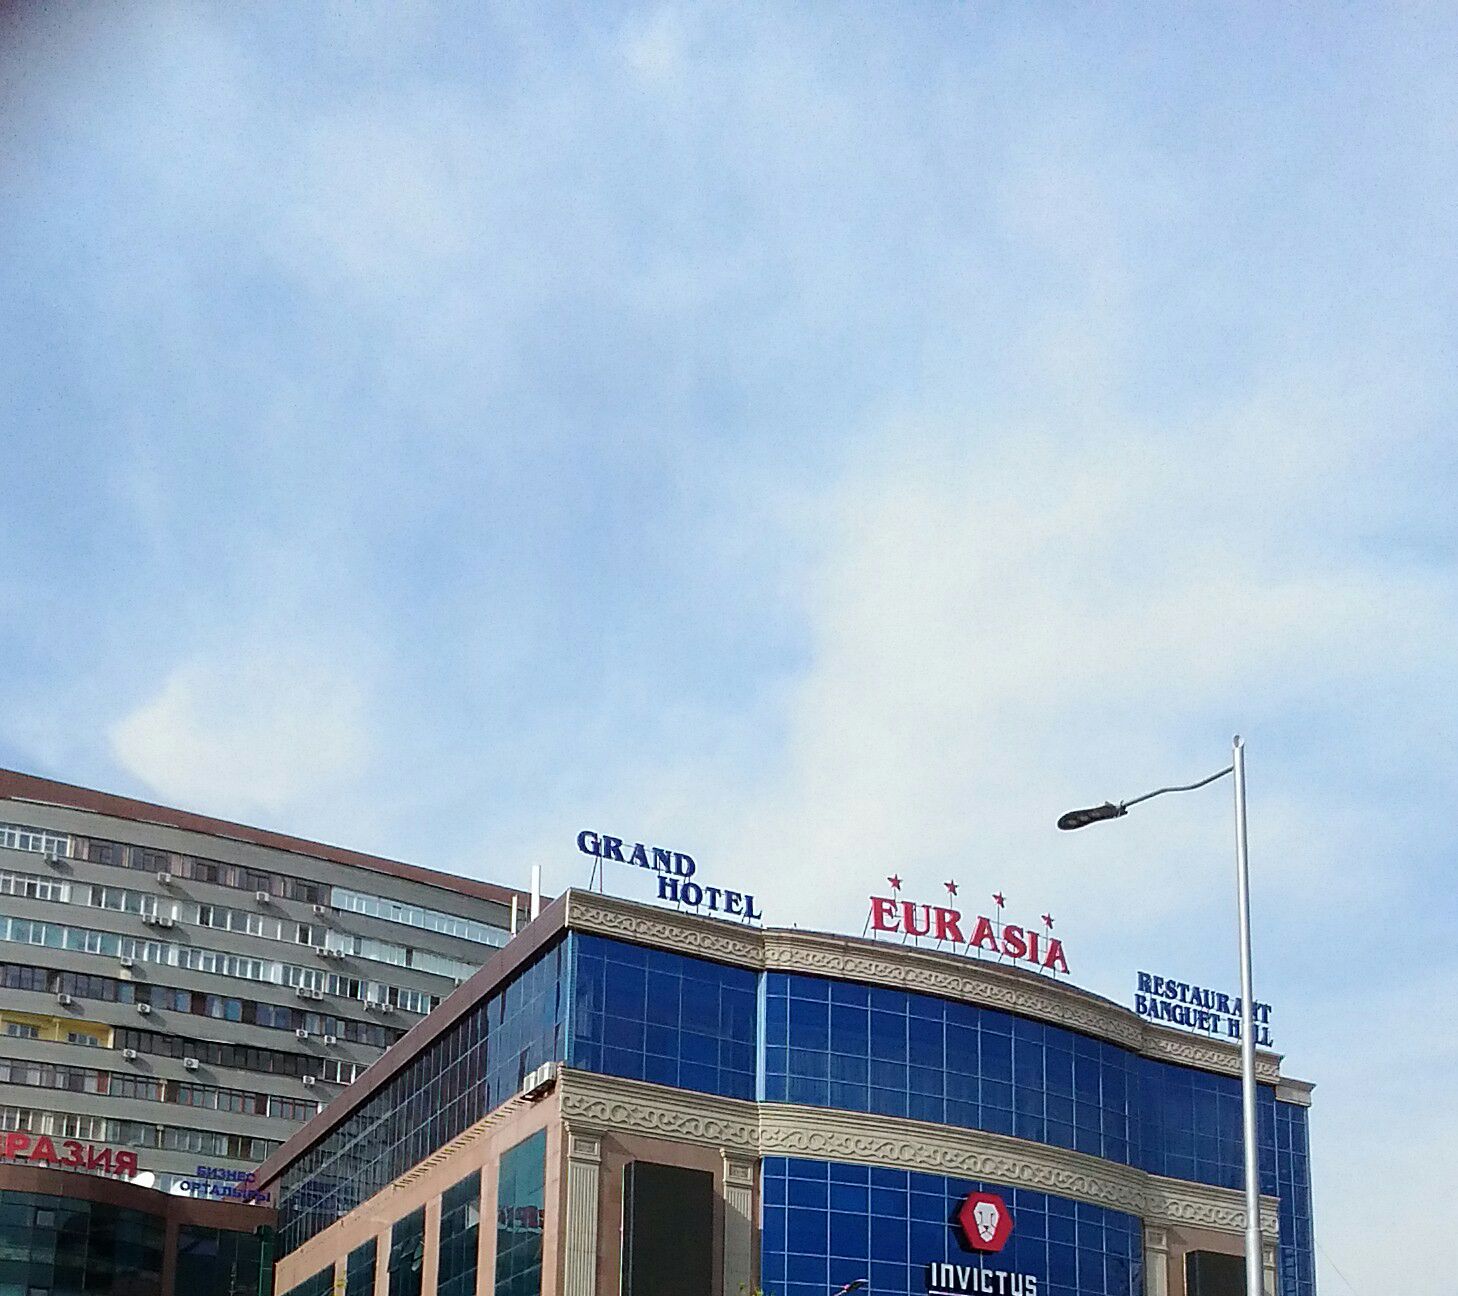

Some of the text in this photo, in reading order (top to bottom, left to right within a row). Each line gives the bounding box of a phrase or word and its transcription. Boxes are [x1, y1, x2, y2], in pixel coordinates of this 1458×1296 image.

[577, 831, 696, 877] GRAND
[657, 876, 763, 920] HOTEL
[870, 896, 1070, 975] EURASIA
[1227, 1017, 1273, 1047] HLL
[0, 1130, 138, 1178] РАЗИЯ
[197, 1165, 256, 1183] БИЗНЕС
